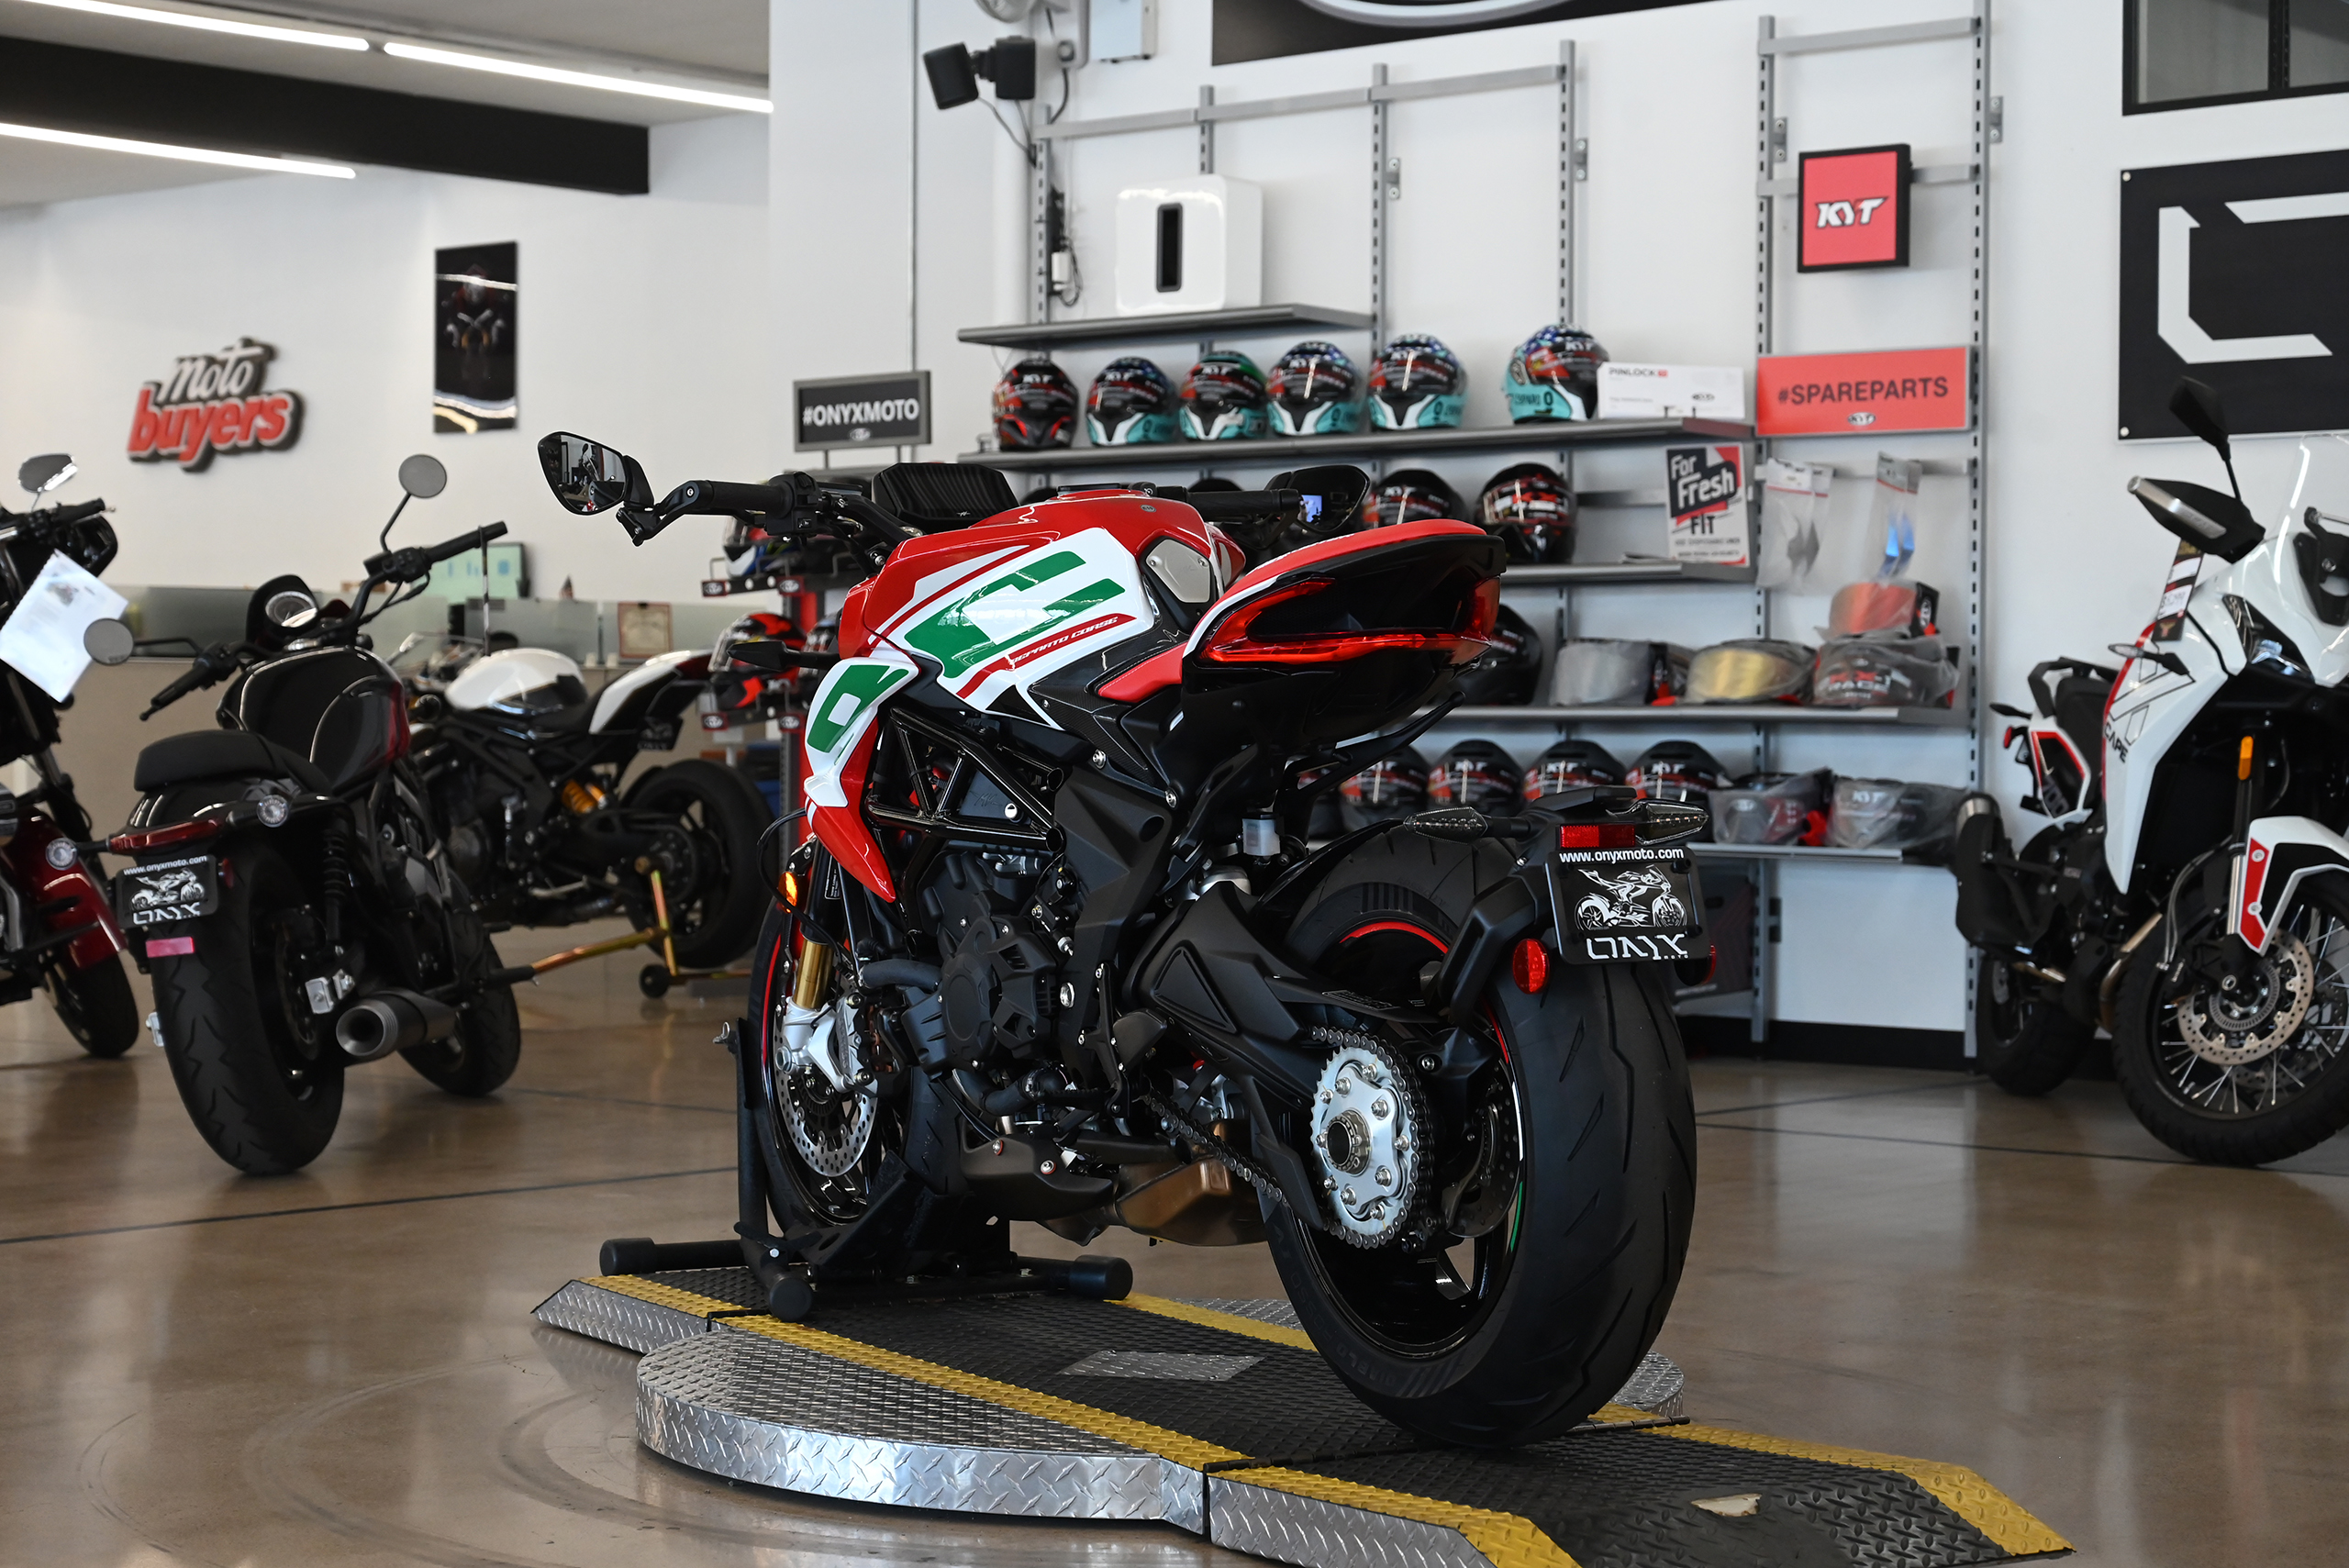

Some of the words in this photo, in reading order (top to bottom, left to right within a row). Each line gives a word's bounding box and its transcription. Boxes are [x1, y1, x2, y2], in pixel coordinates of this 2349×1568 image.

[1815, 195, 1889, 229] KYT
[1777, 376, 1949, 406] #SPAREPARTS
[128, 387, 290, 462] buyers
[802, 397, 919, 428] #ONYXMOTO
[1670, 454, 1698, 480] For
[1677, 467, 1734, 510] Fresh
[1071, 616, 1119, 639] CORSE
[123, 855, 207, 876] www.onyxmoto.com
[1559, 848, 1685, 864] www.onyxmoto.com
[132, 902, 201, 925] ONYX
[1586, 933, 1687, 961] ONYX
